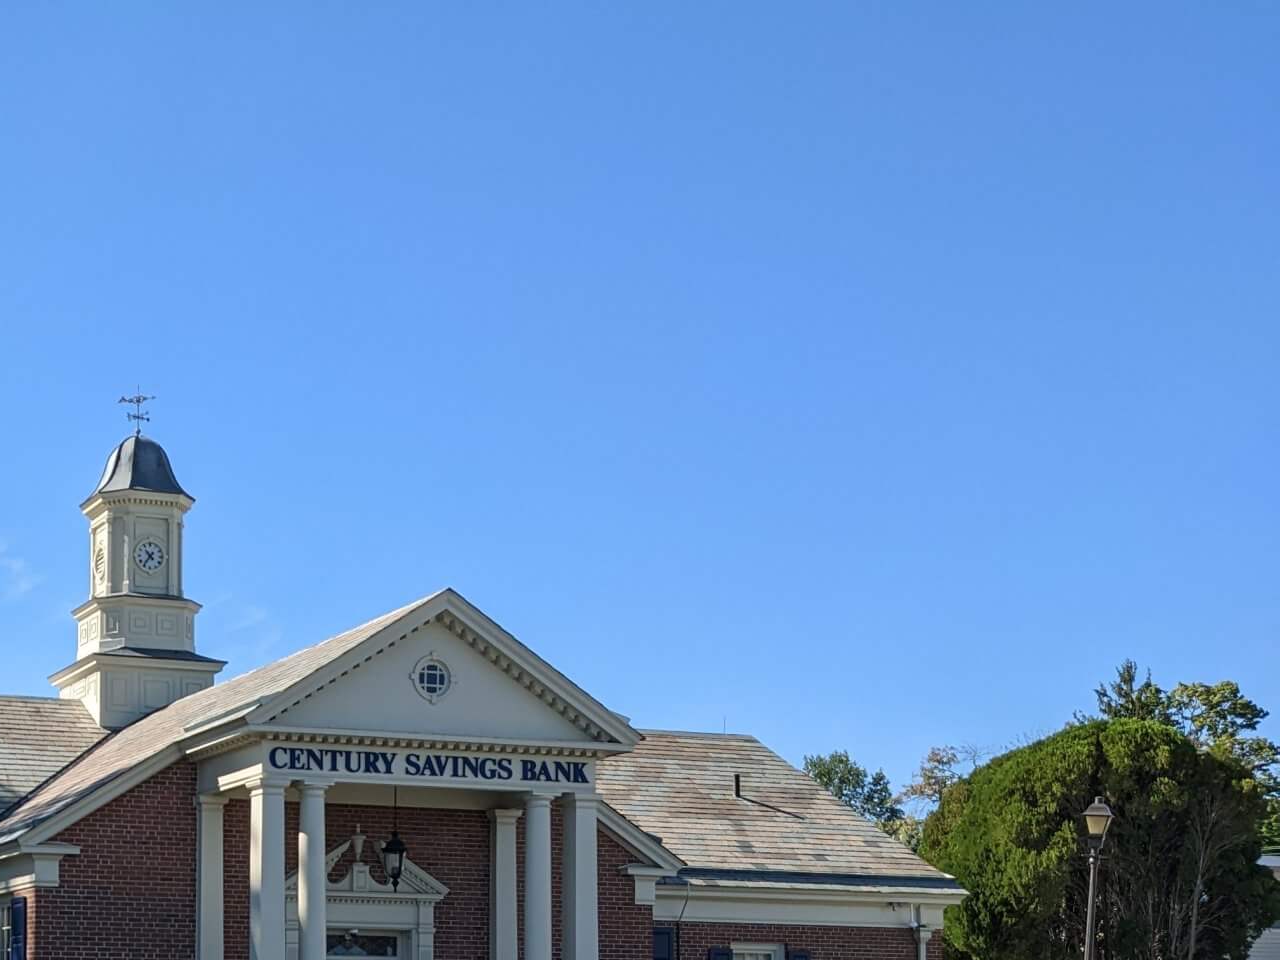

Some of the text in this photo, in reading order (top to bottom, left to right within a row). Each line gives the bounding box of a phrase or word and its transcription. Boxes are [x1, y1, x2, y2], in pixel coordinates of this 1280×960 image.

[268, 746, 590, 783] CENTURY SAVINGS BANK
